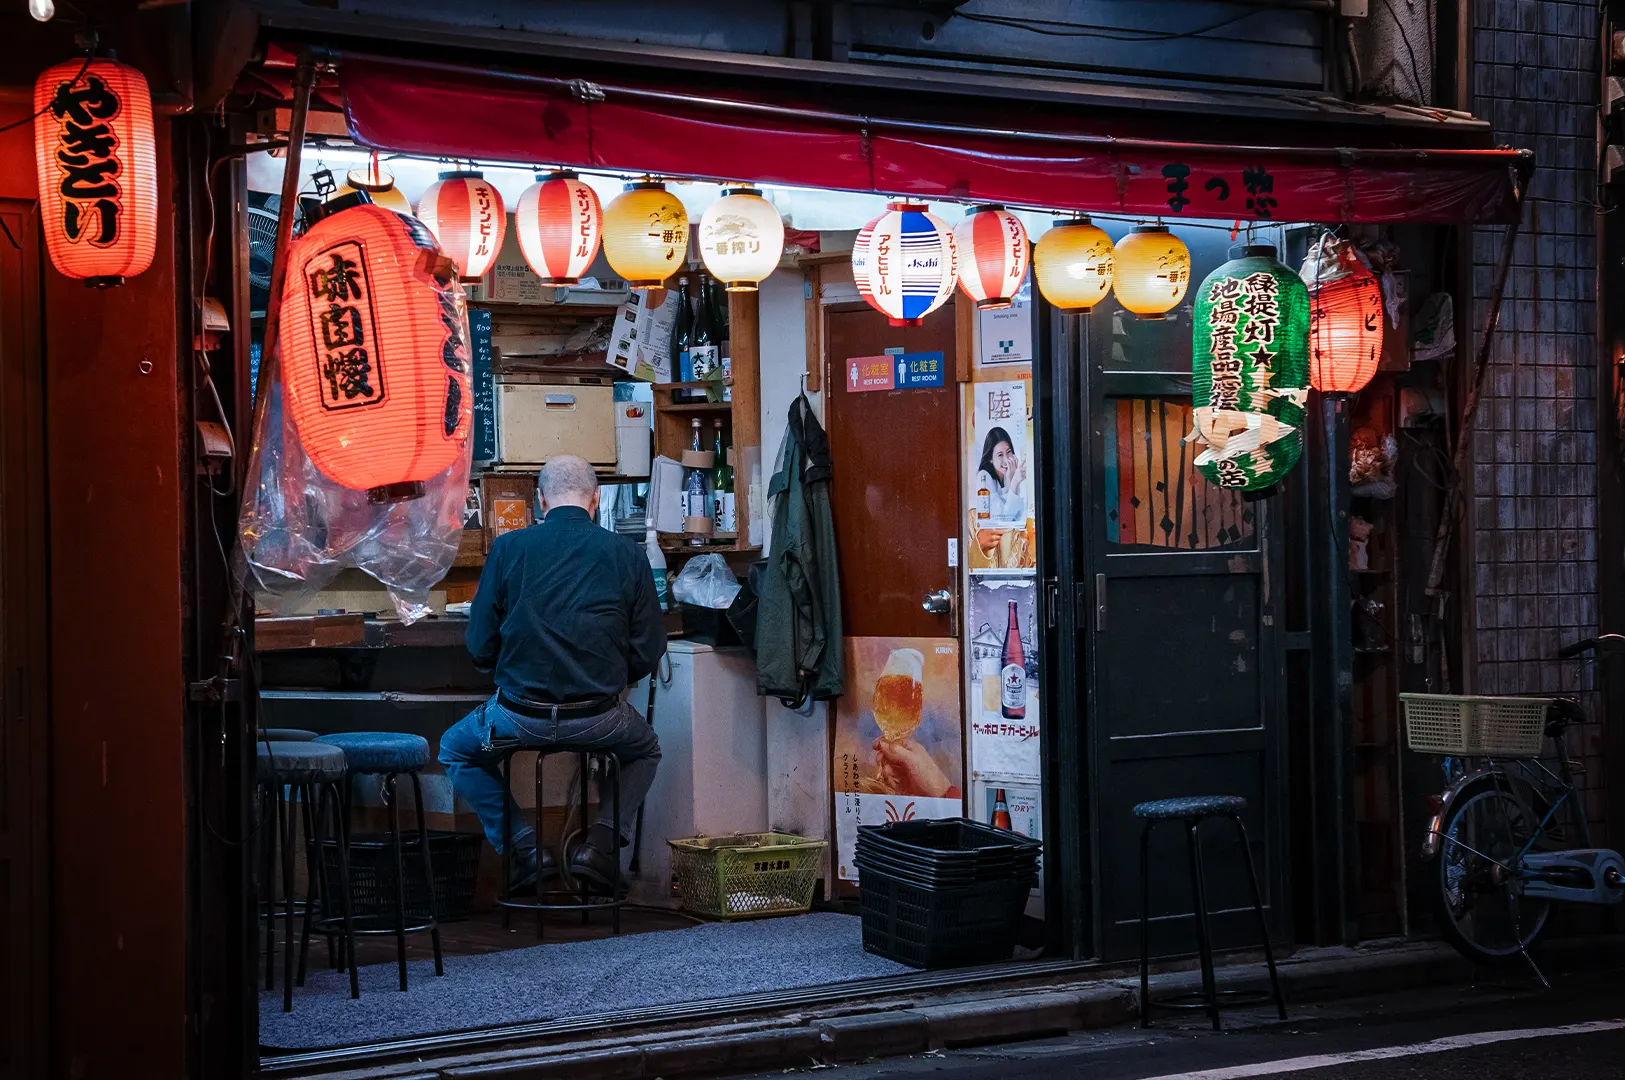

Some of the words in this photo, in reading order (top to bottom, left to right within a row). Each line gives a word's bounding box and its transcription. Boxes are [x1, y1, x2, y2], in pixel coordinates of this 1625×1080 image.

[51, 76, 122, 247] やきとり
[1161, 163, 1278, 218] まつ惣
[475, 186, 492, 257] キリンビール
[575, 188, 591, 258] キリンビール
[705, 240, 761, 256] 一番搾り
[1004, 215, 1022, 279] キリンビール
[852, 257, 866, 267] sahi
[877, 233, 892, 296] アサヒビール
[907, 257, 939, 269] Asahi
[942, 232, 959, 296] アサヒビール
[309, 253, 374, 401] 味自慢
[1243, 272, 1280, 344] 緑提灯
[693, 351, 705, 379] 大辛
[861, 363, 889, 377] 化粧室
[910, 359, 938, 373] 化粧室
[921, 374, 937, 382] ROOM
[988, 390, 1012, 421] 陸
[935, 646, 953, 654] KIRIN
[843, 753, 851, 814] クラフトビール
